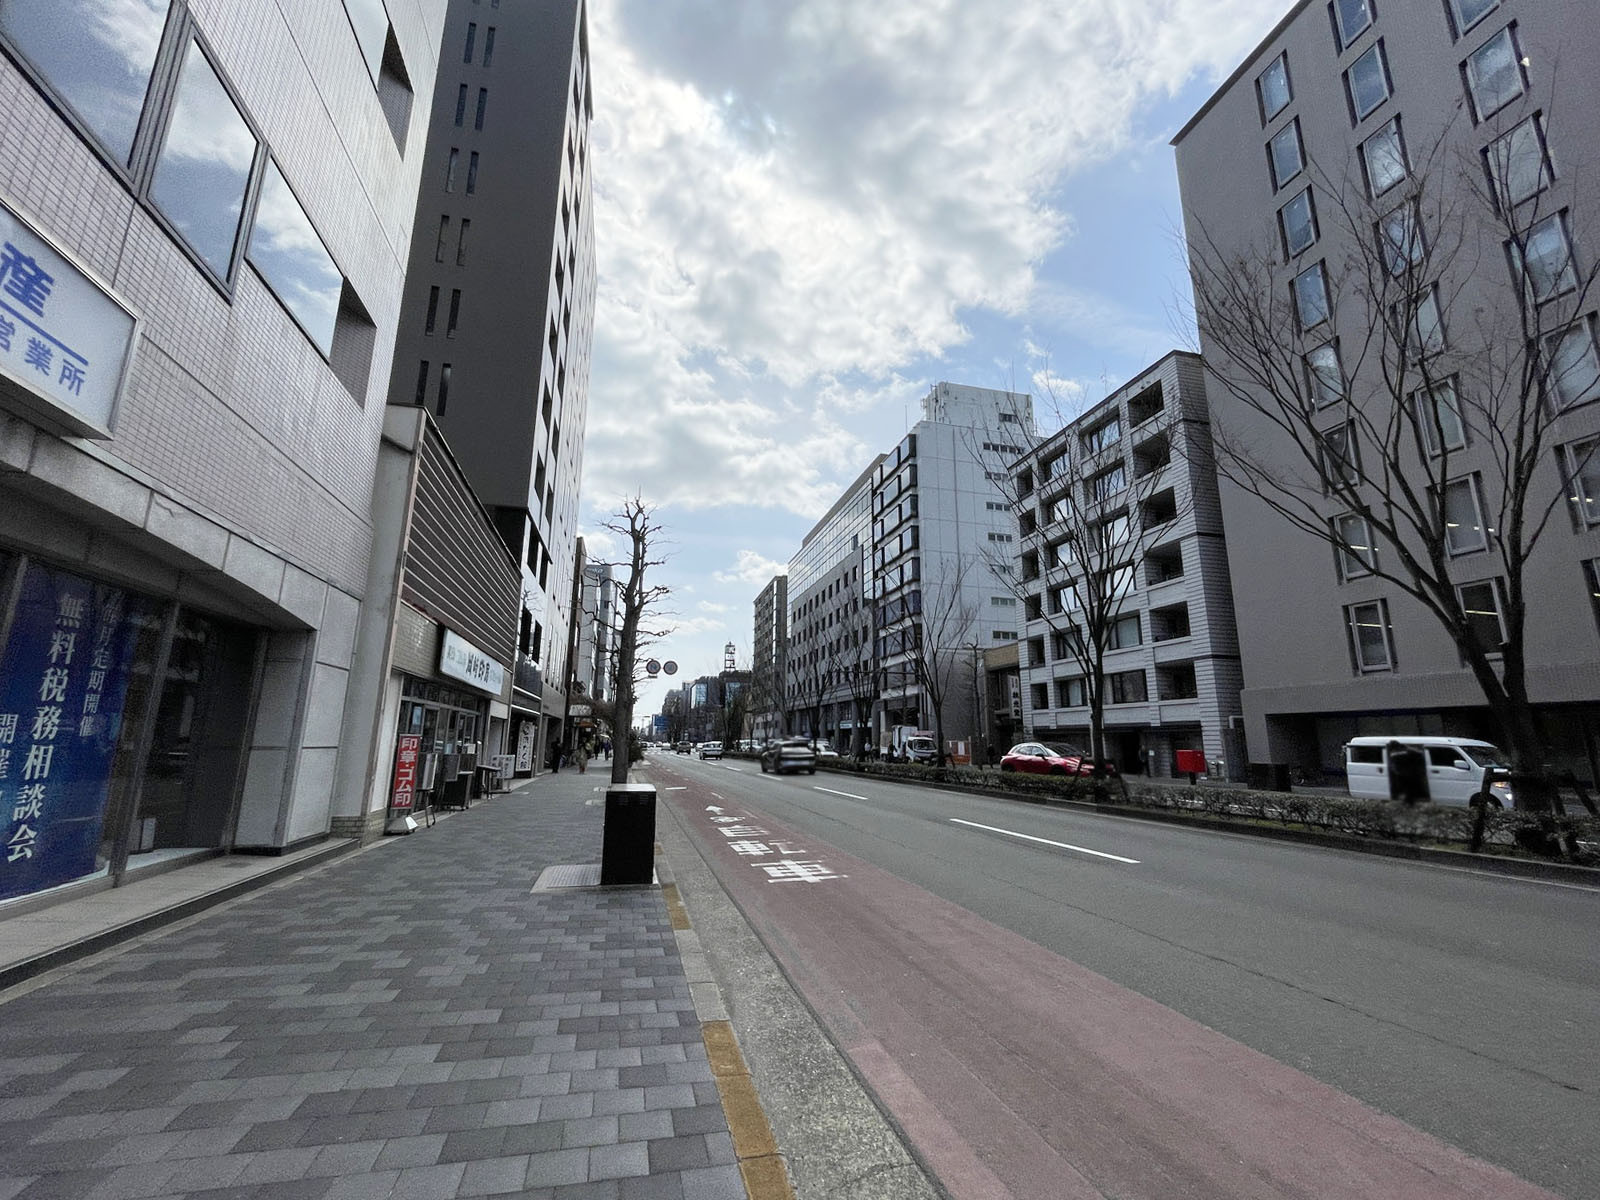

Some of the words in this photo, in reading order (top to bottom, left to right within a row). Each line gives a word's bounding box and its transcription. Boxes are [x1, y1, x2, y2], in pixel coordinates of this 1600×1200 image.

[0, 241, 54, 318] 産
[0, 315, 86, 396] 営業所
[7, 592, 84, 863] 無料税務相談会
